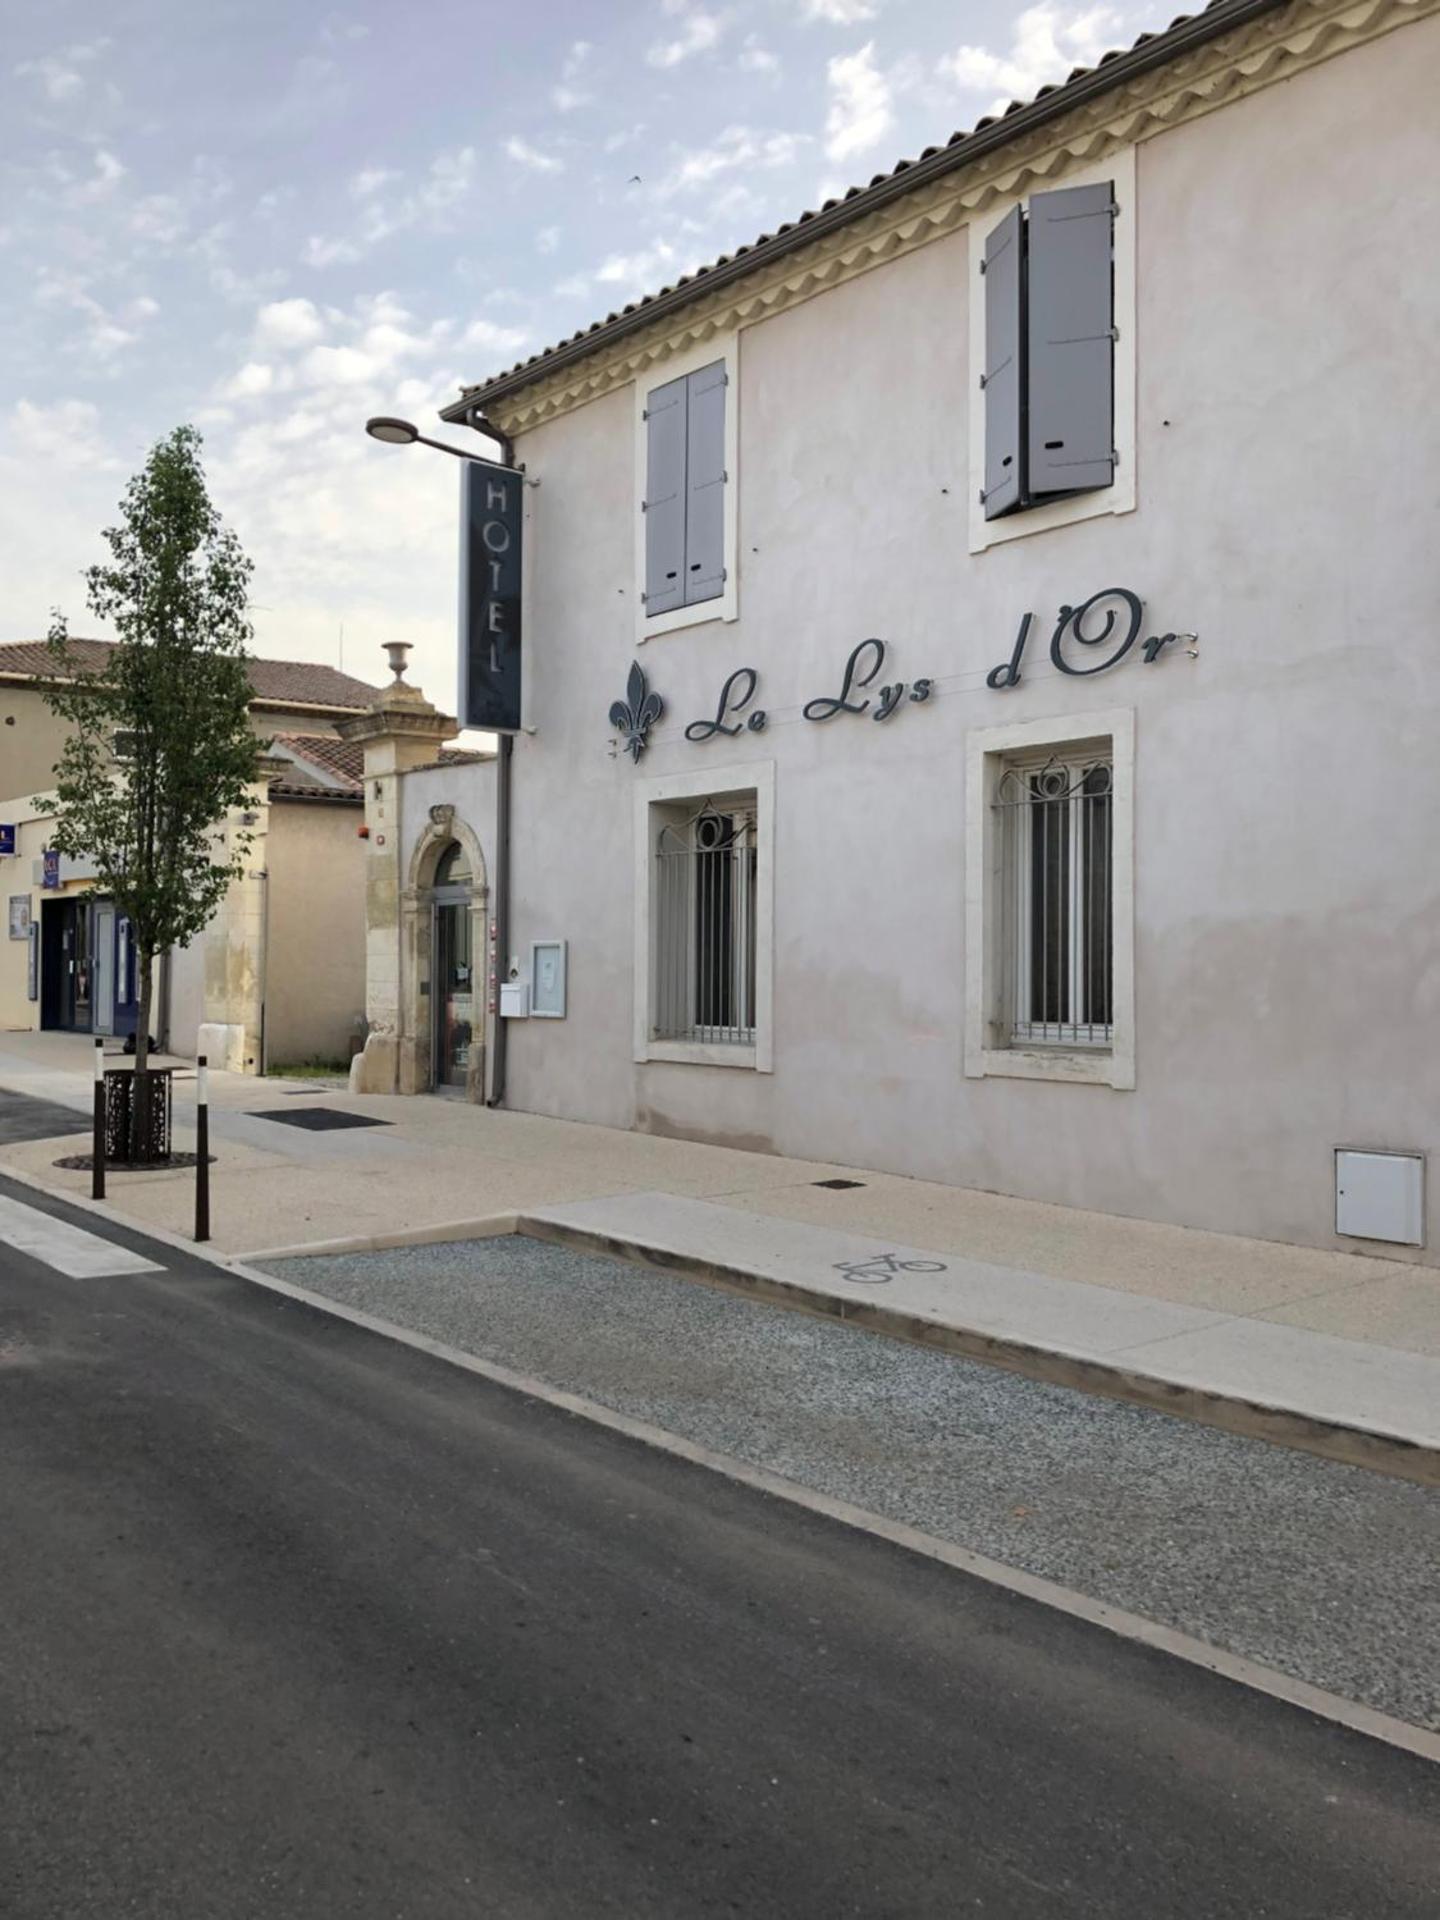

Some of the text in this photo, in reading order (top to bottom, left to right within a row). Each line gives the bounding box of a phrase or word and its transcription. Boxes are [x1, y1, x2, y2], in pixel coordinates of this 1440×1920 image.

[482, 480, 511, 673] HOTEL
[685, 668, 766, 742] Le
[803, 638, 932, 721] Lys
